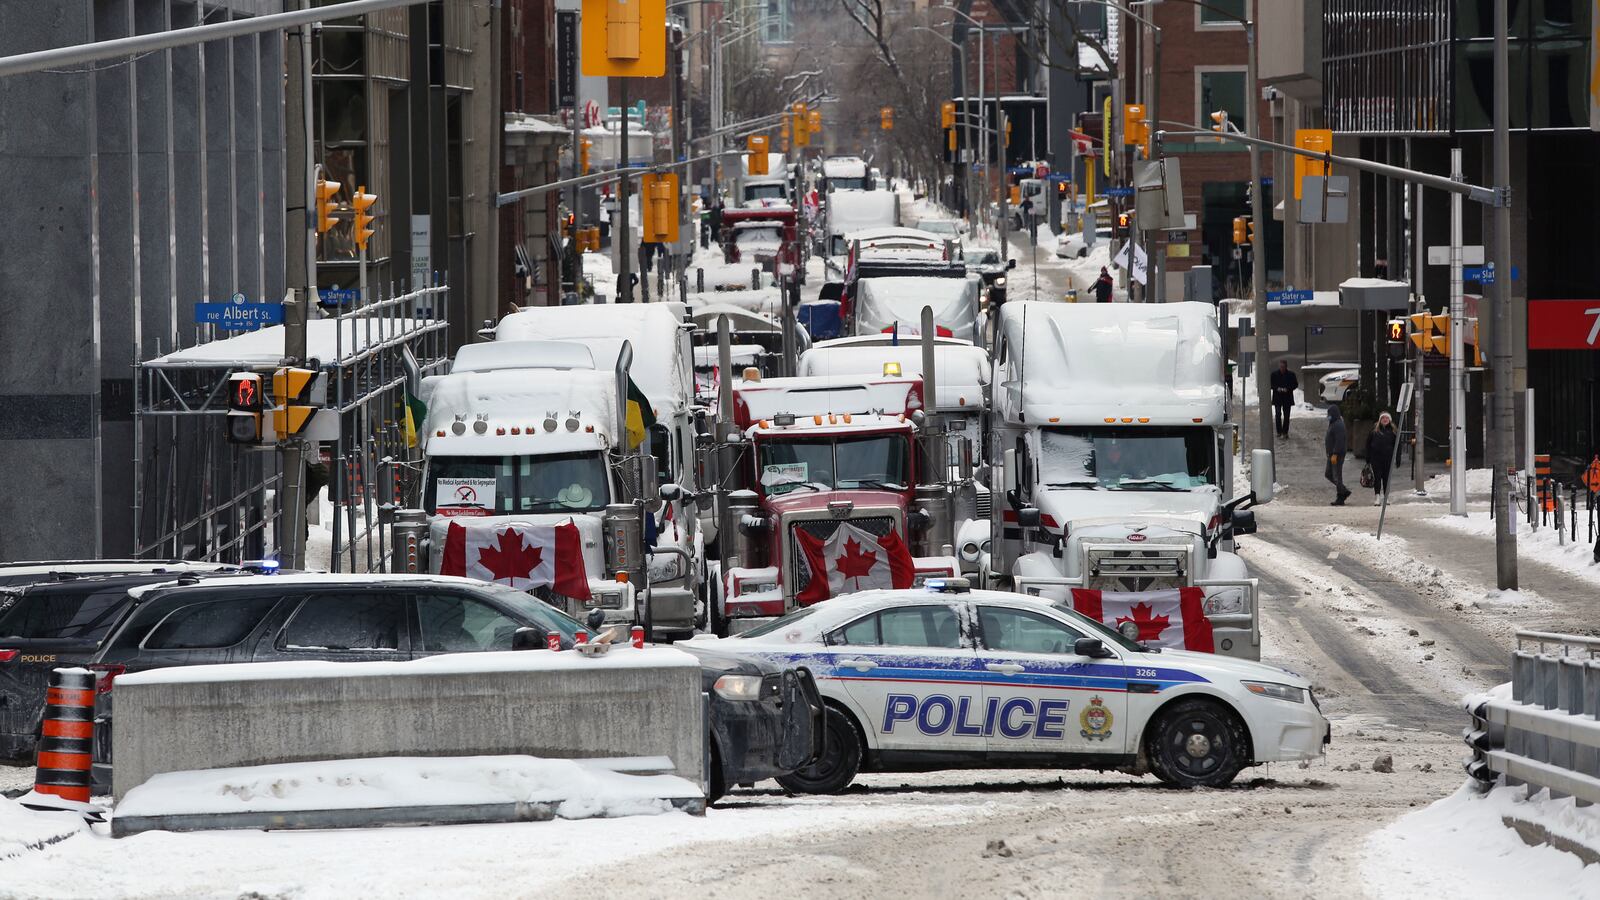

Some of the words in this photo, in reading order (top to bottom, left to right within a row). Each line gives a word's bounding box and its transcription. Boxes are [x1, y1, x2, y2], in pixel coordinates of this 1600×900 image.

[1482, 269, 1495, 279] Slat
[1281, 291, 1299, 300] Slater
[207, 312, 220, 320] rue
[223, 306, 259, 320] Albert
[261, 311, 272, 320] St.
[455, 479, 470, 487] Apartheid
[478, 480, 496, 488] Segregation
[21, 654, 57, 663] POLICE
[1135, 668, 1157, 678] 3266
[881, 693, 1070, 740] POLICE
